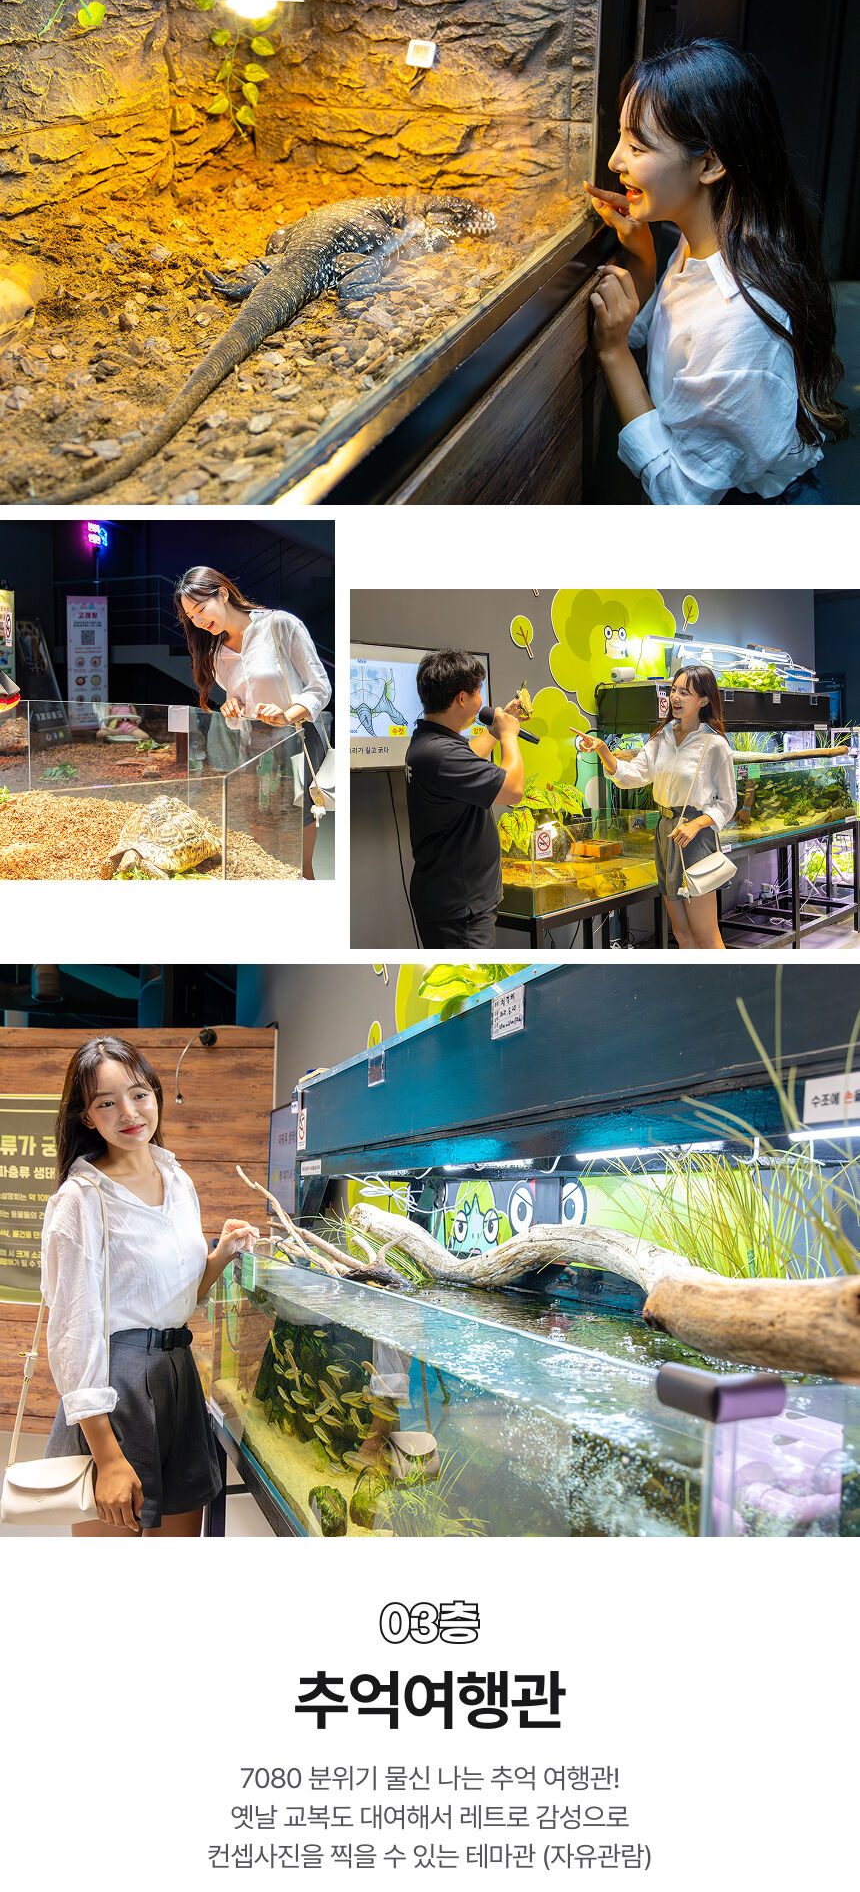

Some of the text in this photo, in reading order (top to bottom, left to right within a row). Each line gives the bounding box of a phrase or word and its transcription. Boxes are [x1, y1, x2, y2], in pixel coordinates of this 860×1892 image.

[350, 747, 364, 755] 리가
[378, 746, 389, 754] 굵다
[811, 1092, 840, 1108] 수조에
[34, 1166, 55, 1180] 생태
